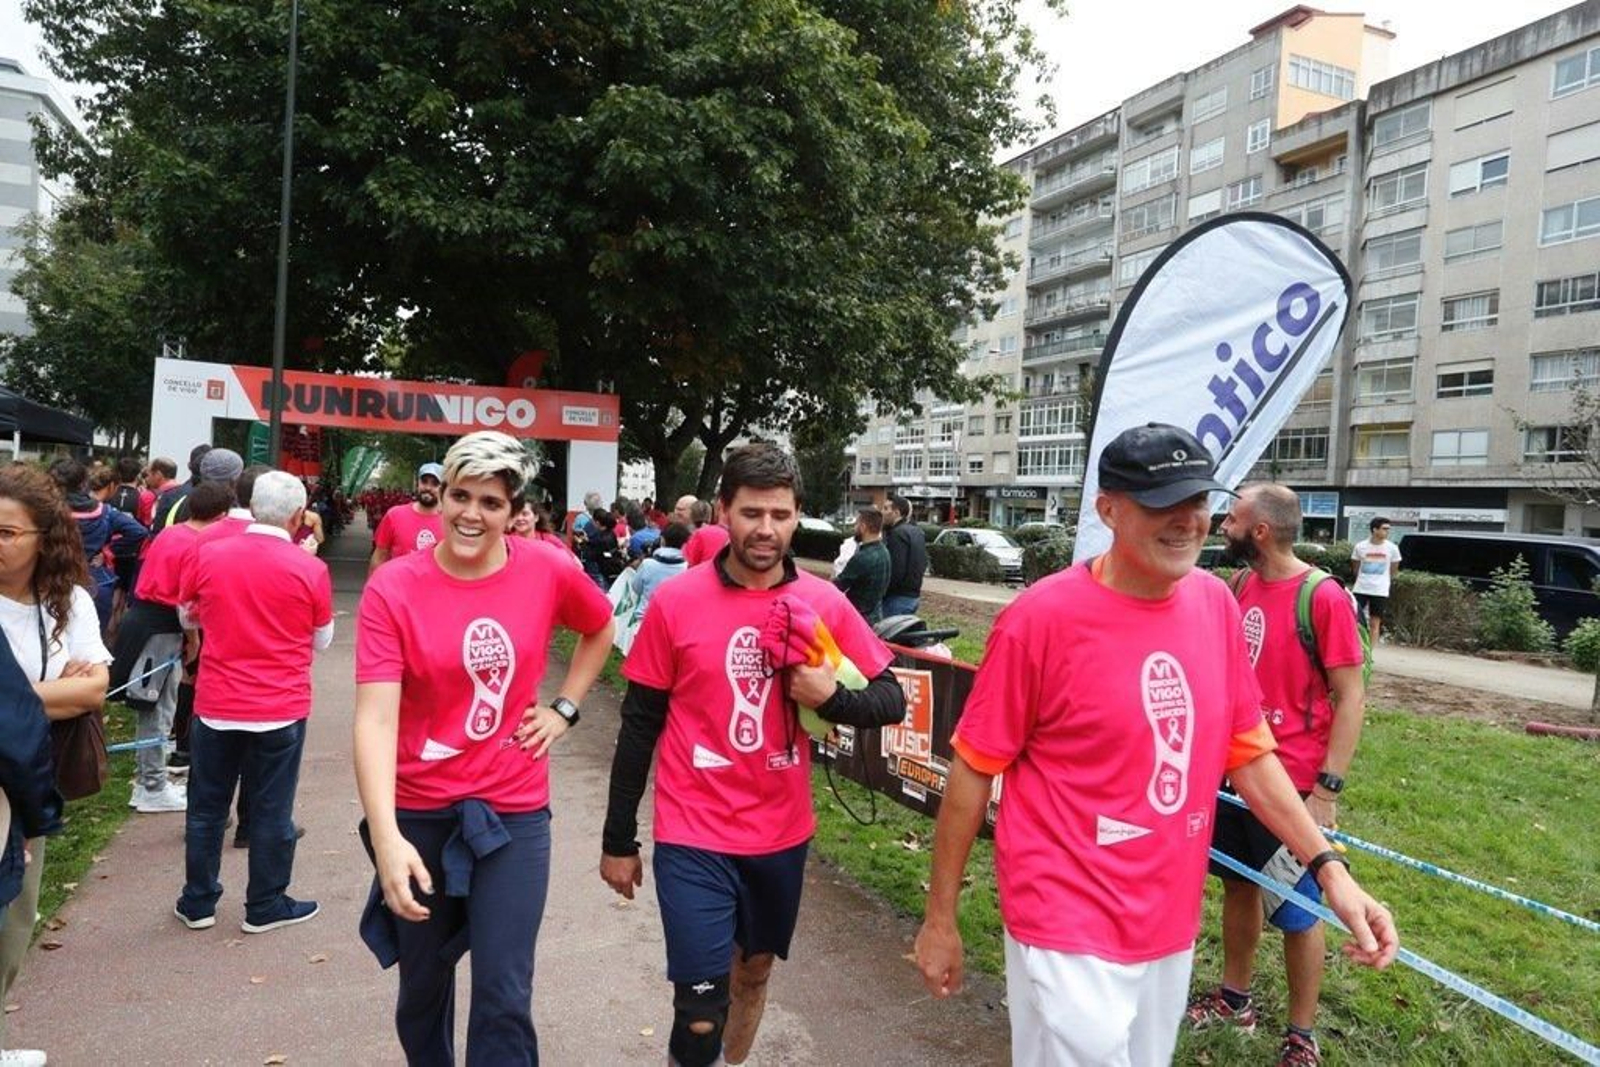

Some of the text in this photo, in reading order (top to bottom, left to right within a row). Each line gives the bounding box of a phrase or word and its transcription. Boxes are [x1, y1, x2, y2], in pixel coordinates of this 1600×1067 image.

[163, 379, 202, 388] CONCELLO
[473, 626, 493, 640] VI
[740, 635, 757, 648] VI
[470, 644, 505, 659] VIGO
[1151, 661, 1173, 679] VI
[1149, 686, 1182, 703] VIGO
